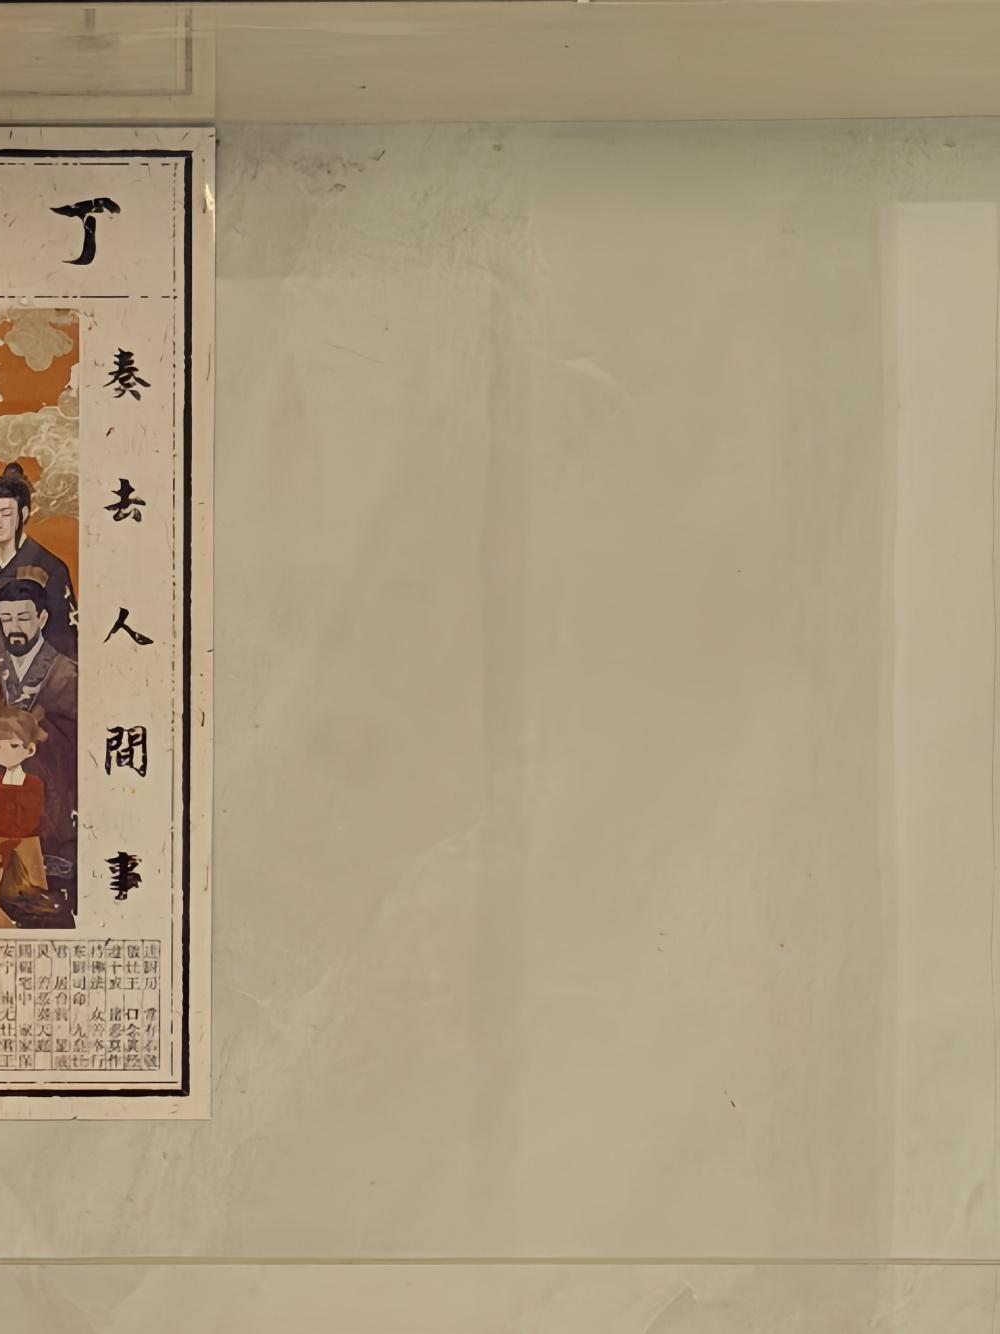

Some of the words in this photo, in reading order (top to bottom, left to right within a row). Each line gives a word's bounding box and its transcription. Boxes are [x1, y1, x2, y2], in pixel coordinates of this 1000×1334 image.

[103, 347, 154, 901] 奏去人間事
